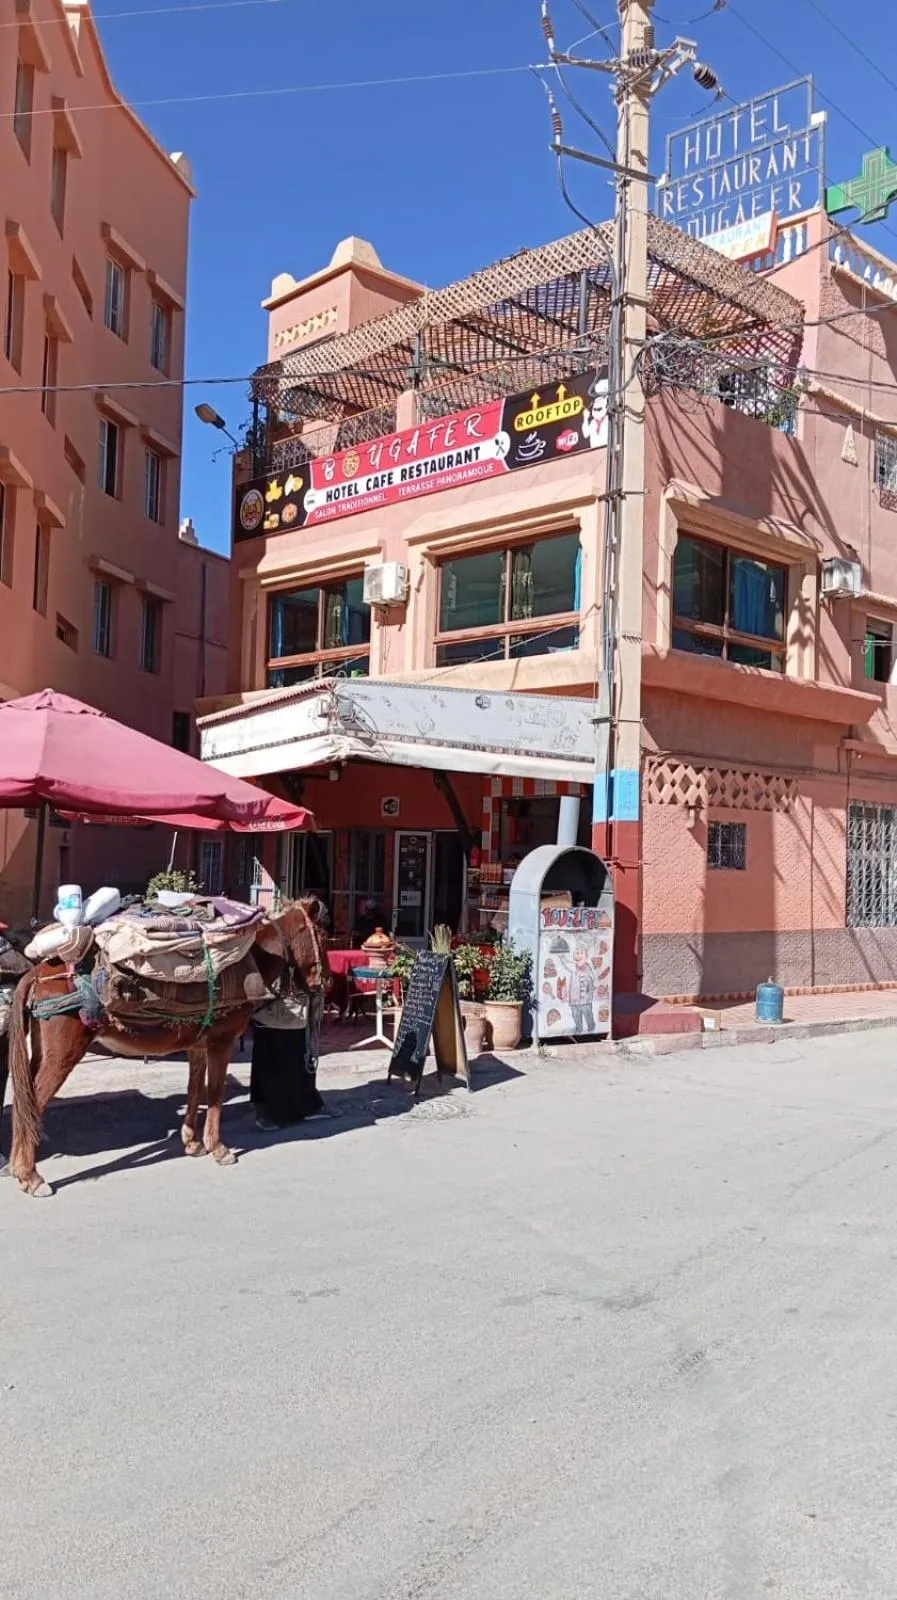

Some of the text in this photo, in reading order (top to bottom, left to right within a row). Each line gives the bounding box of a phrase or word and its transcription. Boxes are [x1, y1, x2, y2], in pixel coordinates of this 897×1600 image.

[684, 95, 791, 169] HOTEL
[662, 132, 814, 217] RESTAURANT
[516, 399, 580, 429] ROOFTOP
[315, 463, 495, 519] SALON TRADITIONNEL TERRASSE PANORAMIQUE
[326, 446, 481, 503] HOTEL CAFE RESTAURANT
